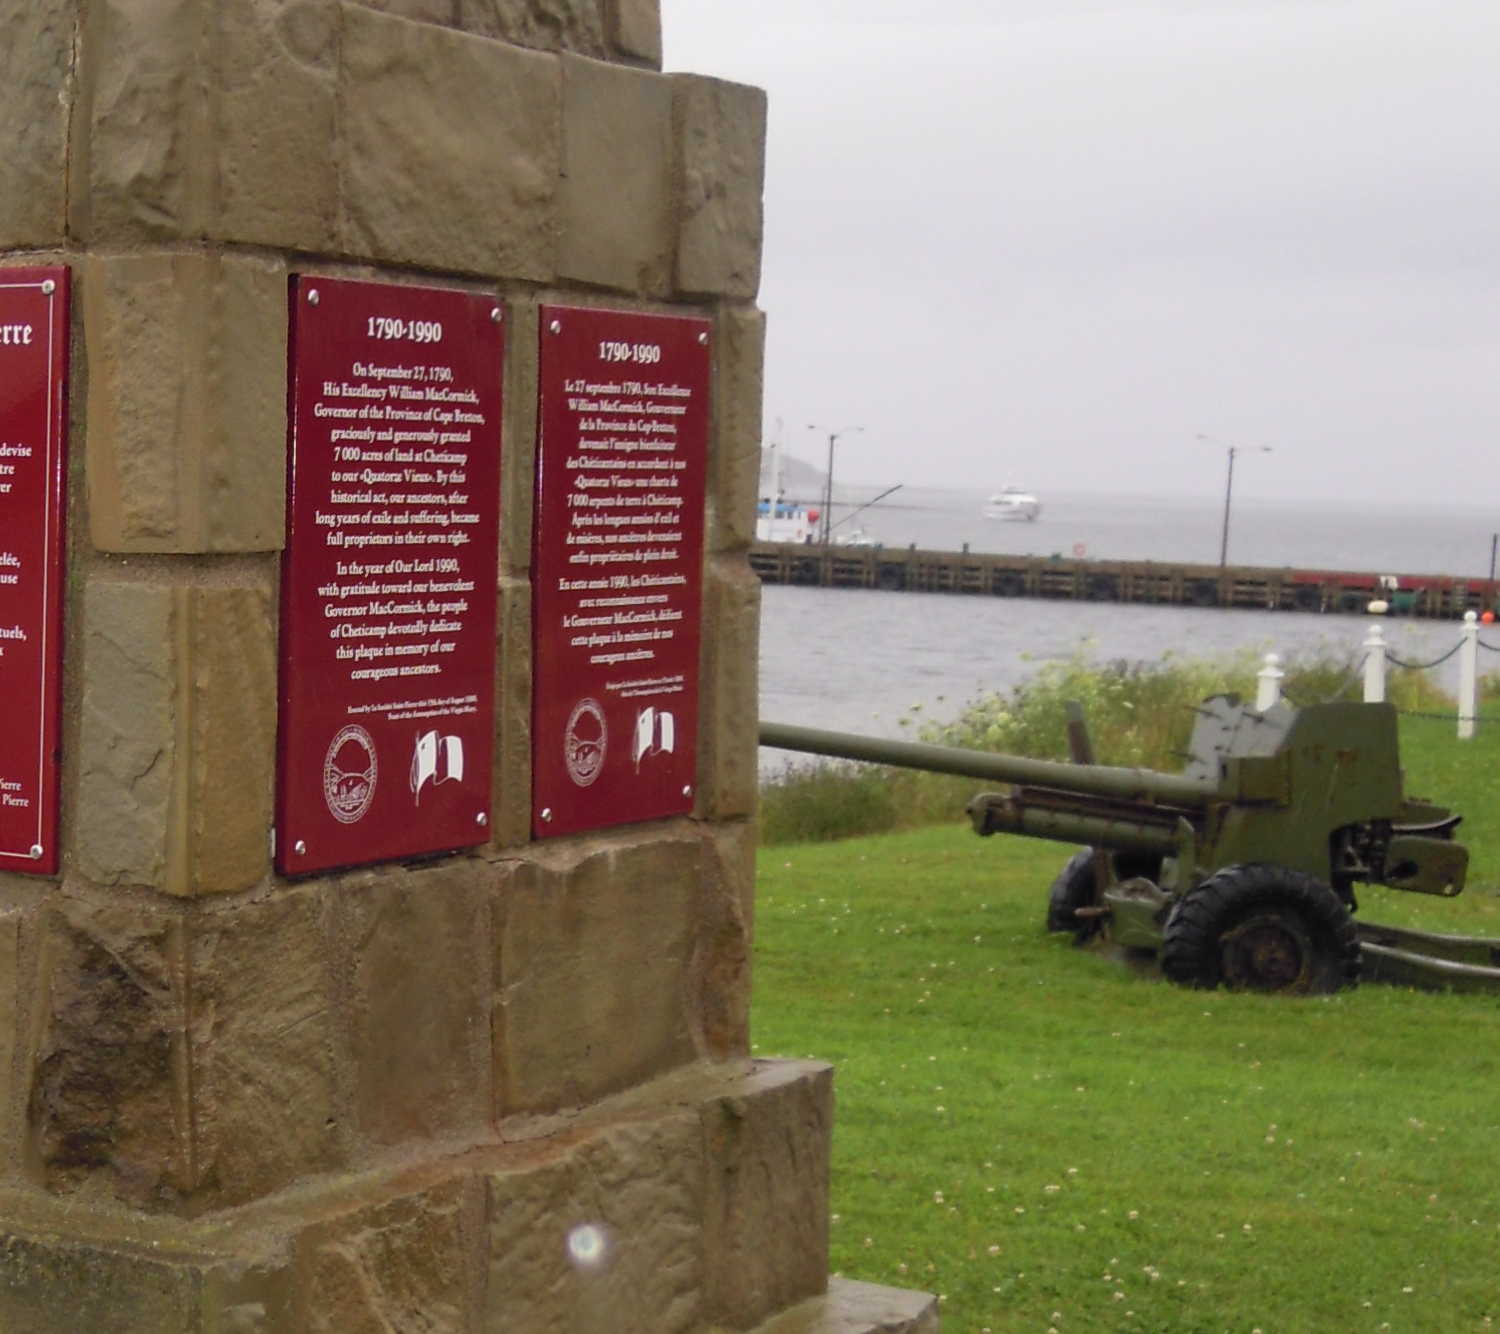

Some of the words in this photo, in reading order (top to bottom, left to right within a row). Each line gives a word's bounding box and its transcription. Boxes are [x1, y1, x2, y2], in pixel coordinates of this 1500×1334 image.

[367, 316, 442, 343] 1790-1990
[599, 341, 661, 364] 1790-1990
[2, 793, 29, 807] Pierre
